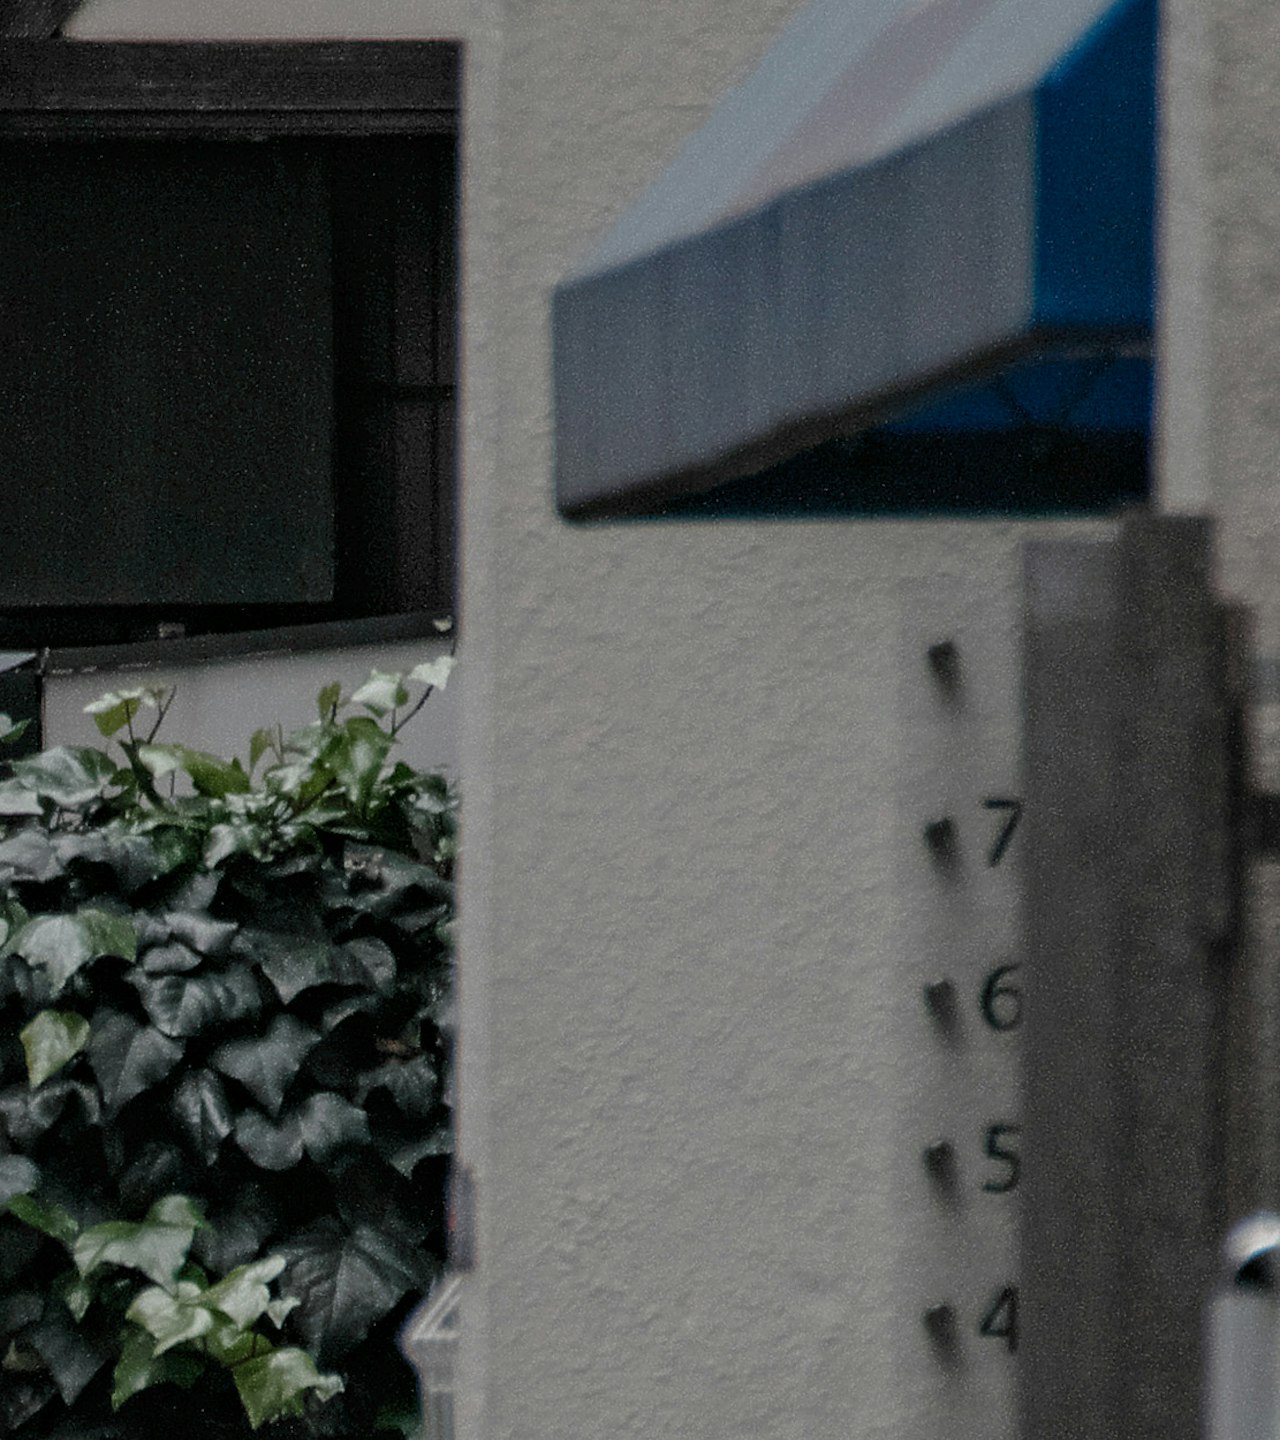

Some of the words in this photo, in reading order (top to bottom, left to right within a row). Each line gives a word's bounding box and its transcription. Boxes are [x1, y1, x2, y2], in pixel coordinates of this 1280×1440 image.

[980, 799, 1023, 869] 7
[979, 963, 1023, 1032] 6
[980, 1122, 1023, 1195] 5
[978, 1285, 1020, 1356] 4
